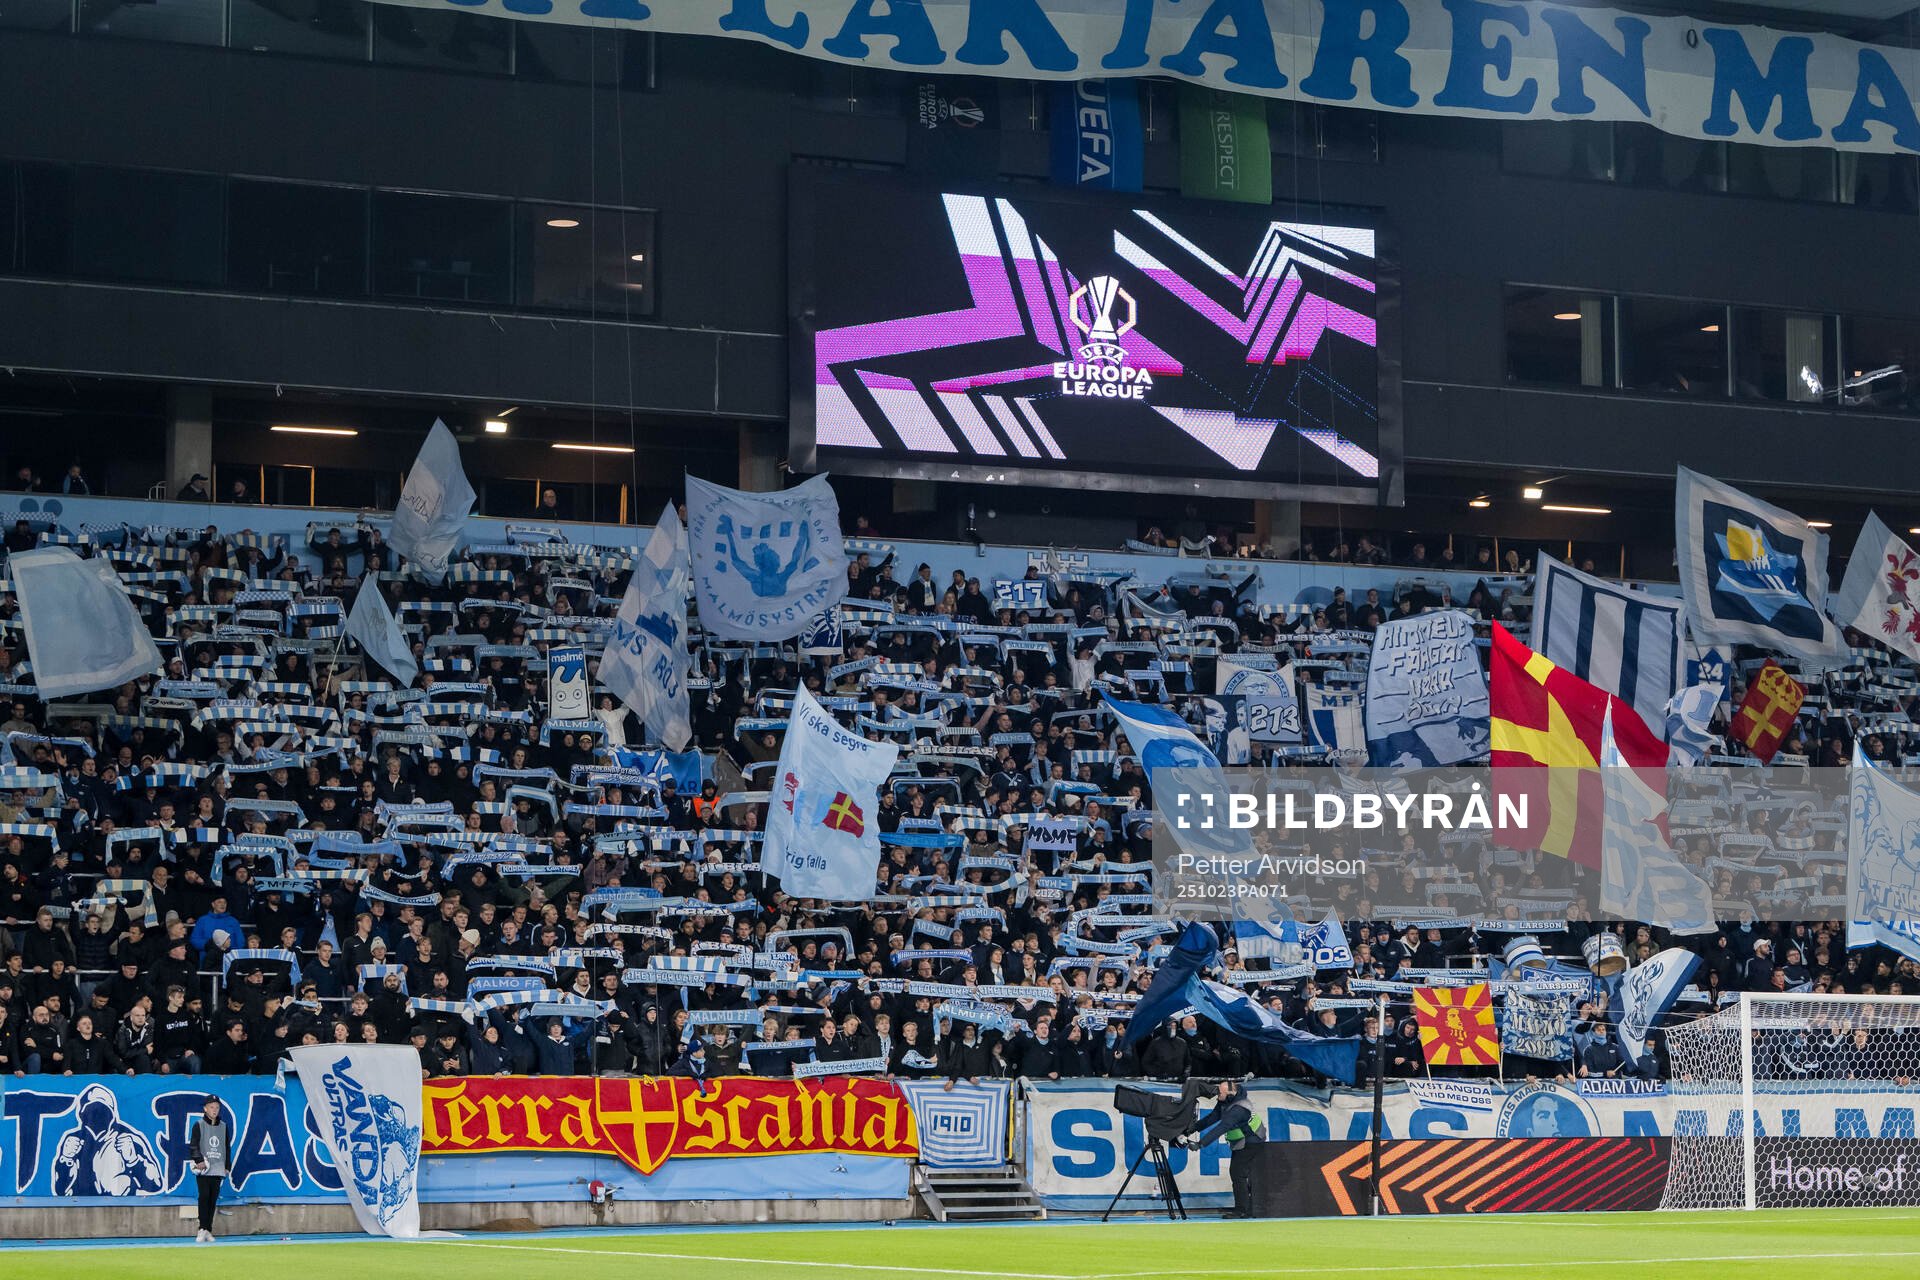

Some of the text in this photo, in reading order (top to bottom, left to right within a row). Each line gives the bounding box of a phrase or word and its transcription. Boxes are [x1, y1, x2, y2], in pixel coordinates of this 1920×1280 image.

[1077, 78, 1112, 182] UEFA
[1216, 110, 1235, 190] RESPECT
[1080, 345, 1124, 362] UEFA
[1053, 362, 1153, 384] EUROPA
[1062, 381, 1146, 399] LEAGUE
[808, 714, 830, 736] ska
[832, 729, 868, 752] segra
[786, 848, 827, 870] rig falla
[1479, 920, 1503, 930] JENS
[1519, 920, 1563, 930] LARSSON
[1493, 982, 1580, 991] JES LARSSON
[1582, 1080, 1664, 1094] ADAM VIVE
[1447, 1093, 1469, 1103] MED
[1471, 1096, 1492, 1106] OSS
[322, 1073, 349, 1153] ULTRAS
[933, 1113, 972, 1133] 1910
[1770, 1154, 1908, 1191] Home of
